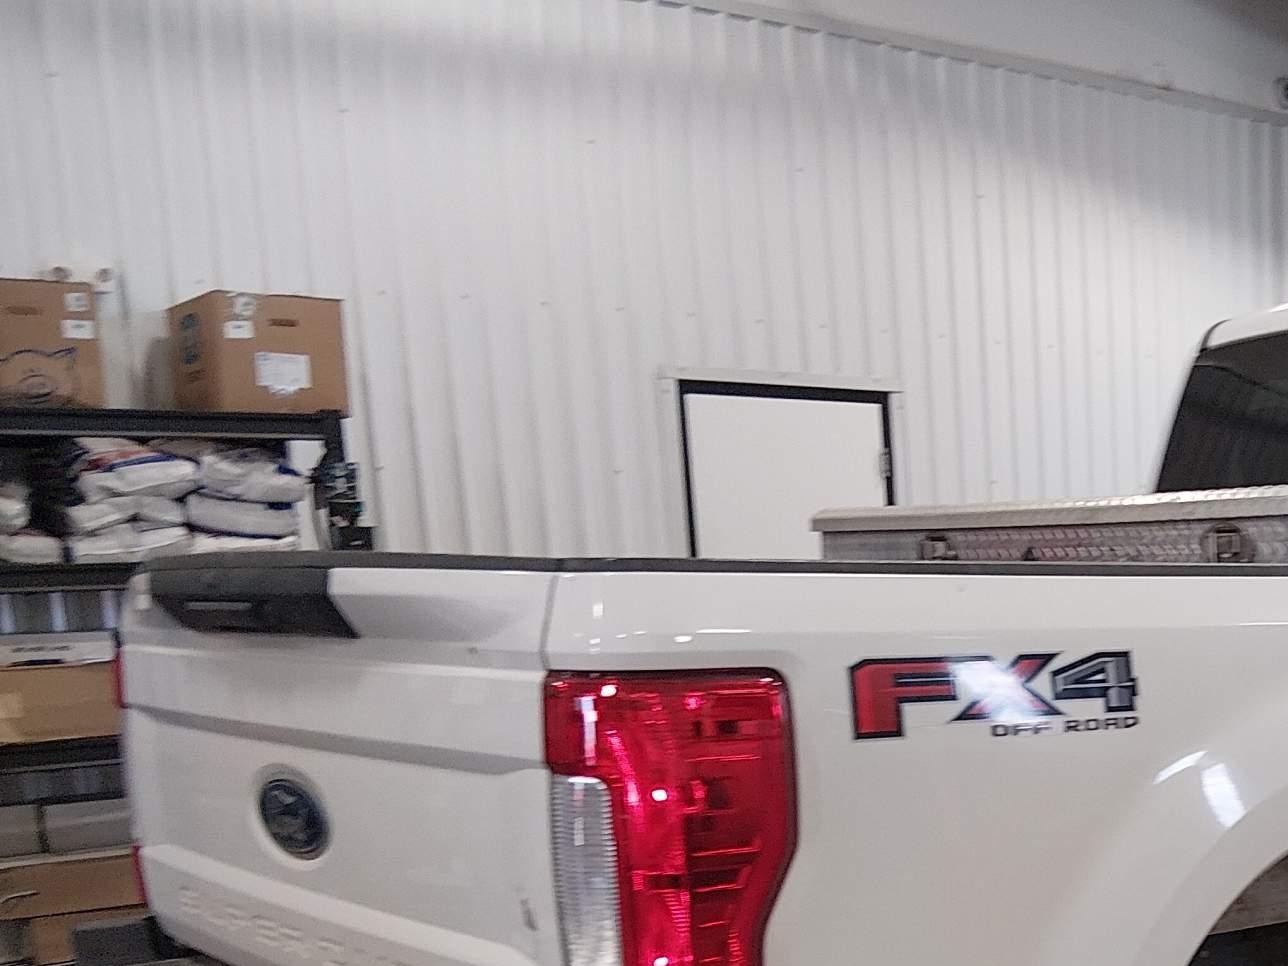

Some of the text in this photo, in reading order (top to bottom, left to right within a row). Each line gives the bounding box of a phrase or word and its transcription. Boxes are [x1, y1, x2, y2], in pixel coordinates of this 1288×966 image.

[849, 650, 1138, 739] FX4
[991, 716, 1138, 738] OFF ROAD
